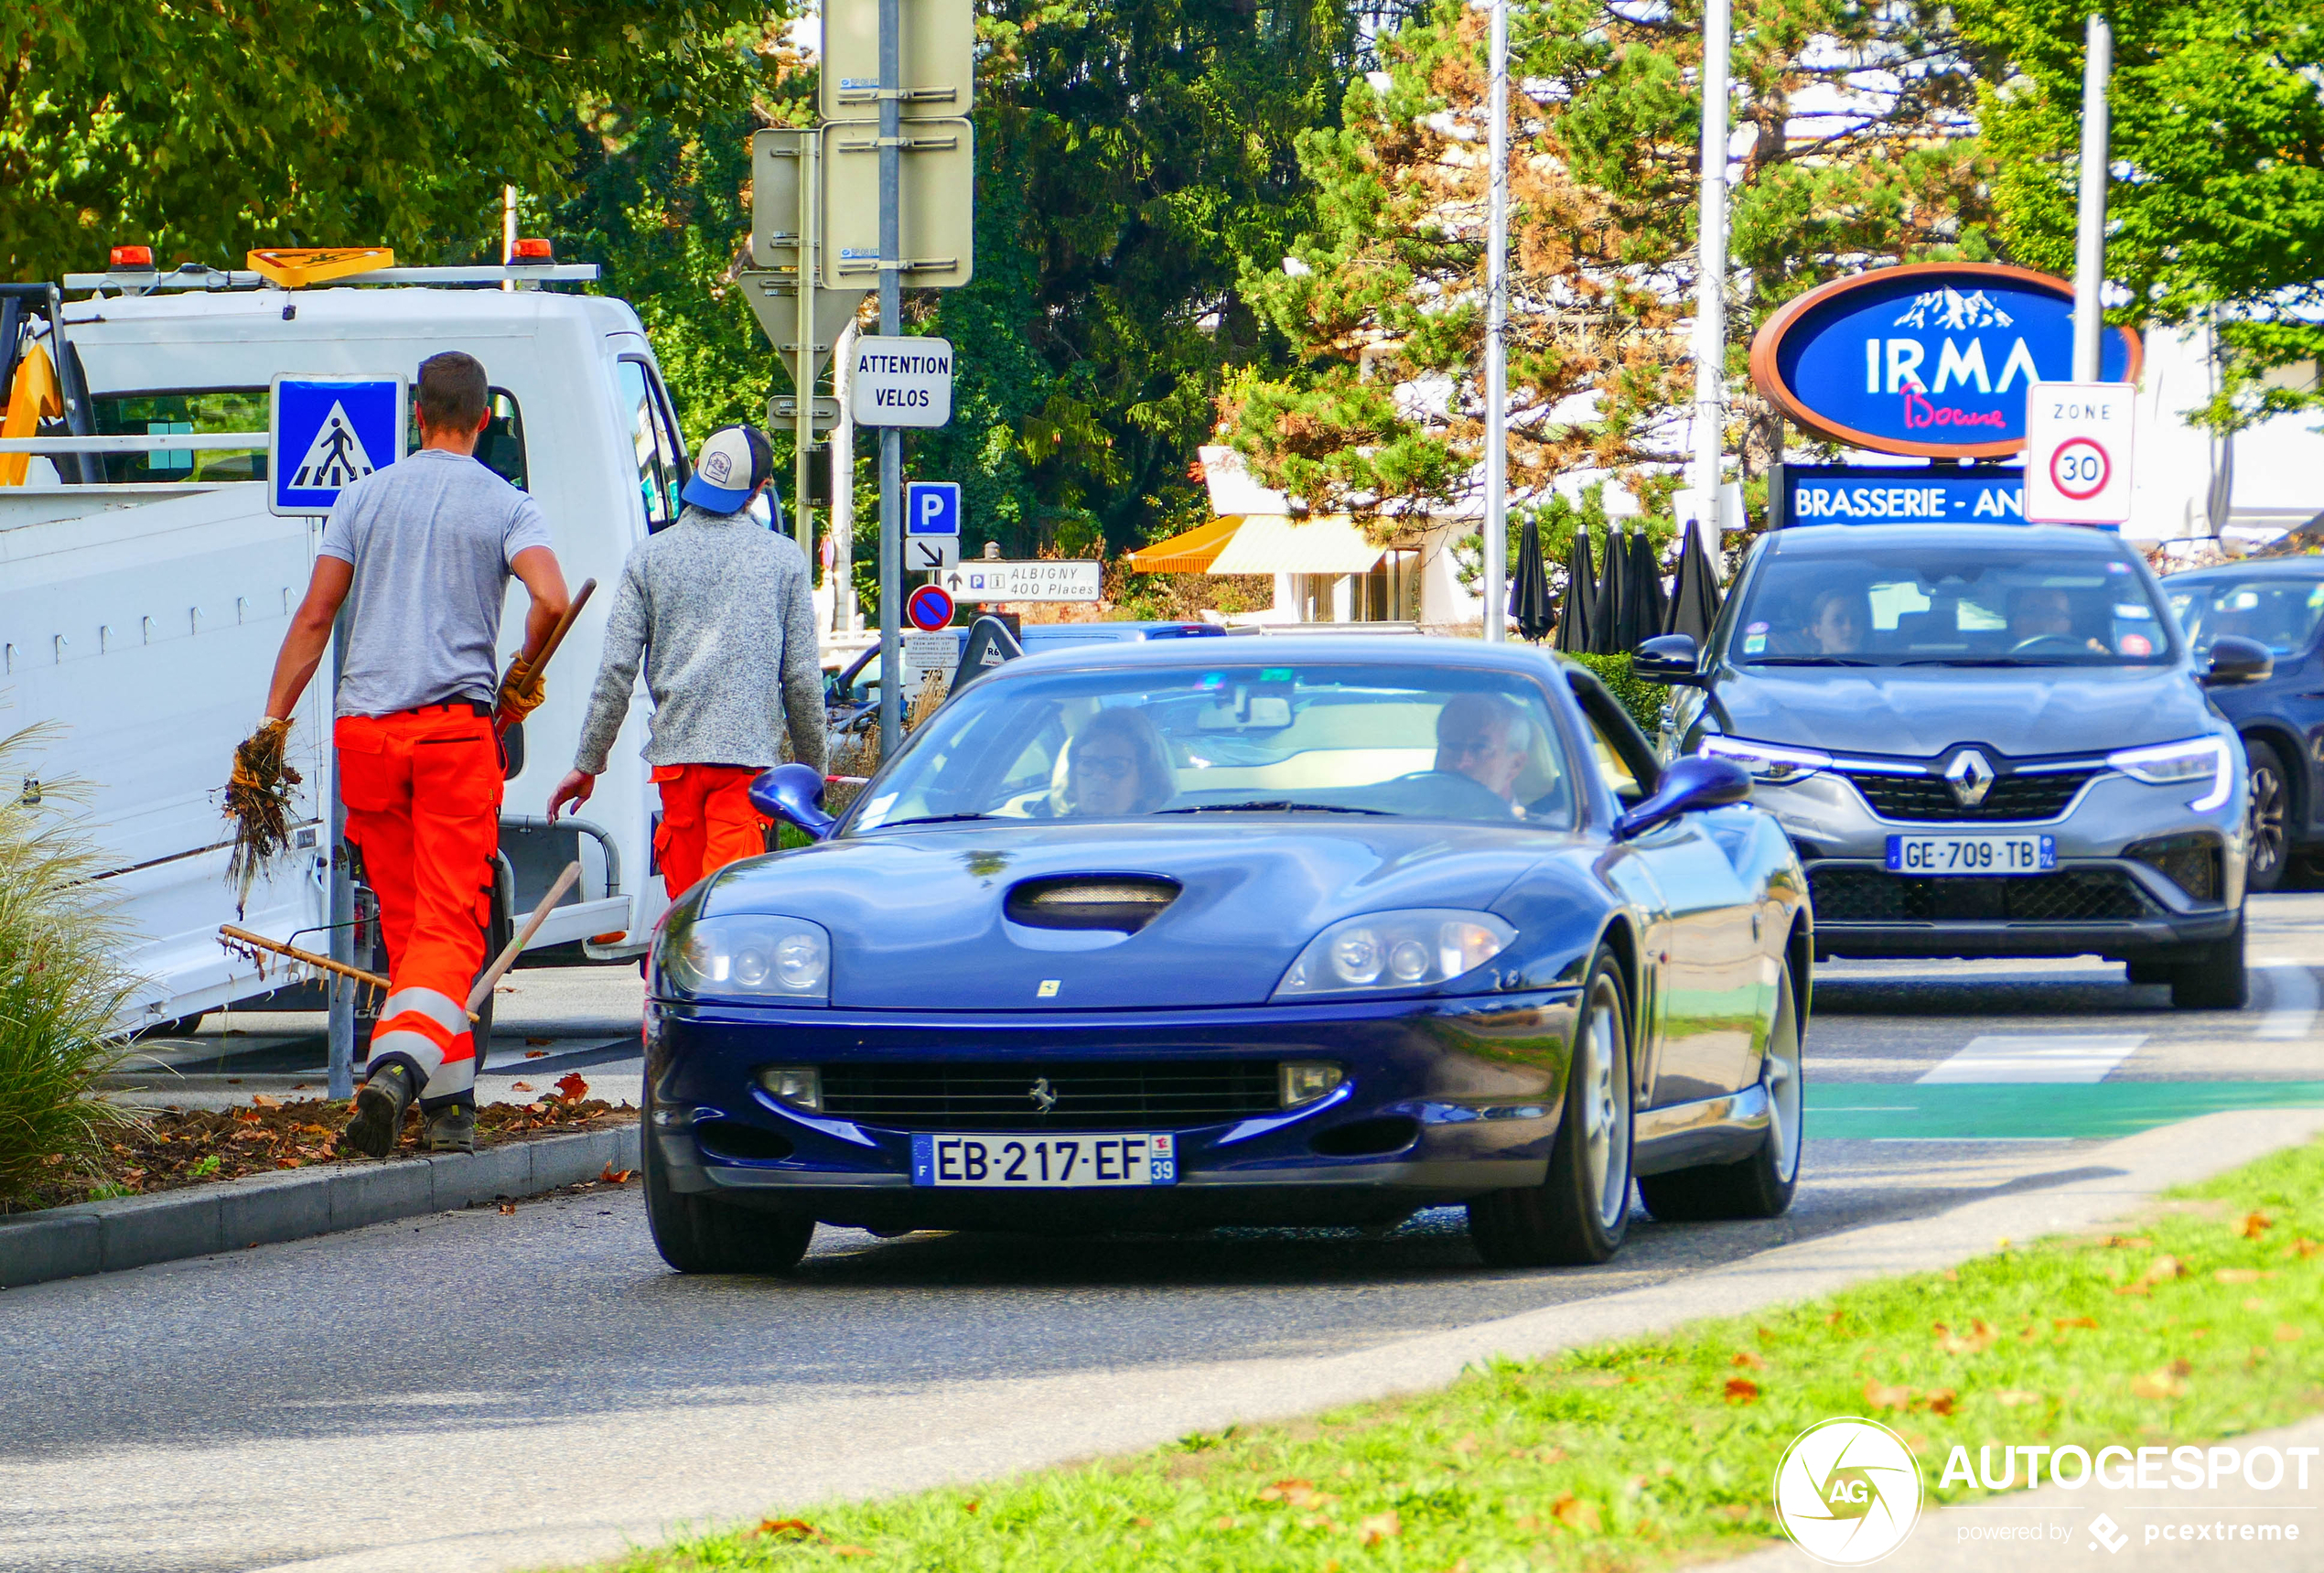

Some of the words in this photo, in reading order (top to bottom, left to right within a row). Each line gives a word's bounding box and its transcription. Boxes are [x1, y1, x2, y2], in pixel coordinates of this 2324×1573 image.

[858, 355, 948, 374] ATTENTION
[1867, 337, 2040, 393] IRMA
[876, 389, 929, 407] VELOS
[2054, 404, 2111, 420] ZONE
[2062, 457, 2098, 481] 30
[921, 494, 944, 525] P
[1796, 488, 1946, 518] BRASSERIE
[1973, 488, 2023, 517] AN
[973, 576, 983, 587] P
[1011, 568, 1078, 579] ALBIGNY
[1011, 584, 1039, 595] 400
[1049, 584, 1093, 595] Places
[987, 648, 999, 656] R6
[1907, 842, 2034, 868] GE-709-TB
[919, 1166, 927, 1177] F
[1152, 1160, 1174, 1180] 39
